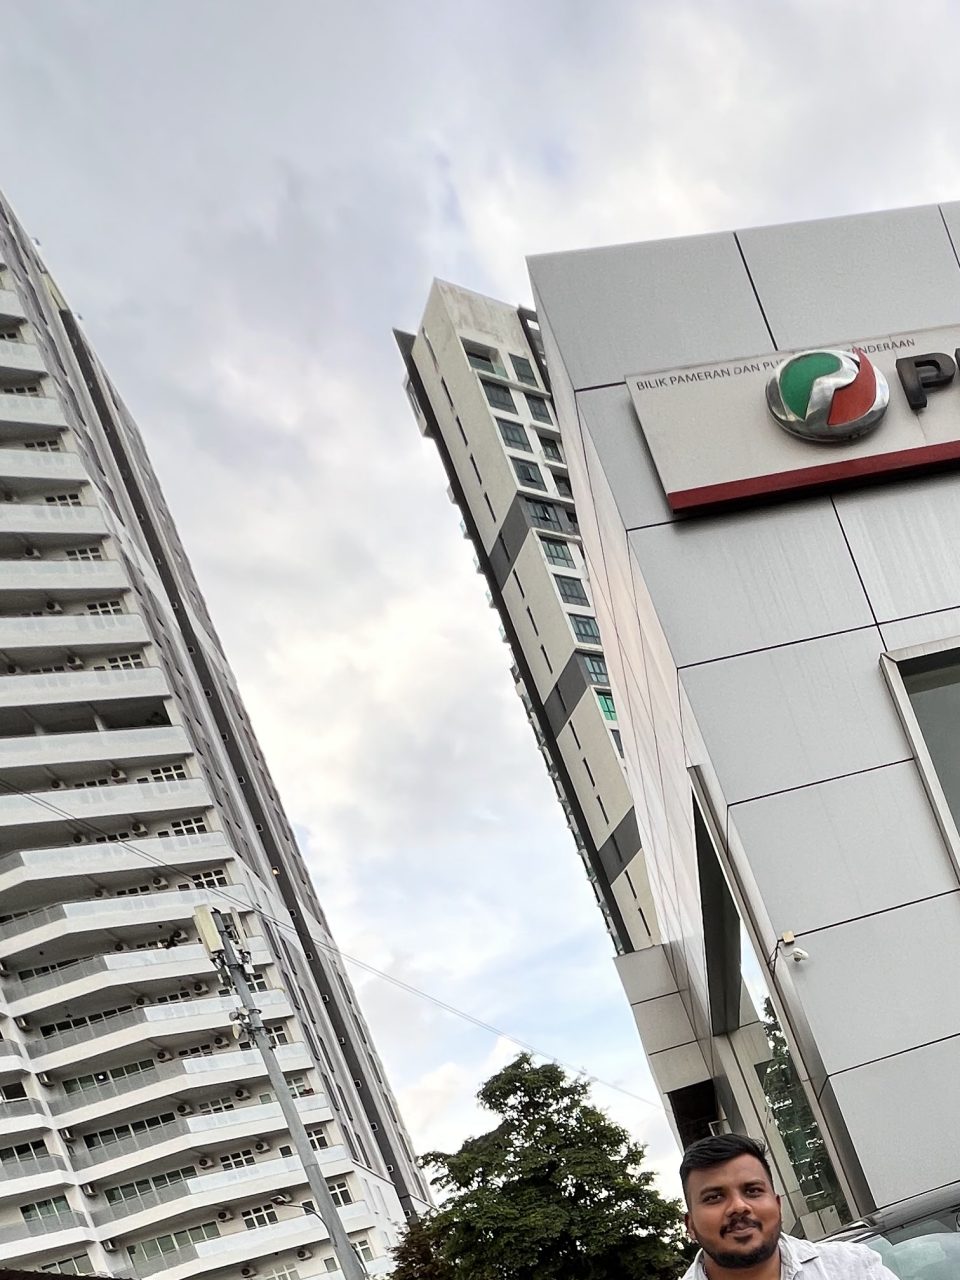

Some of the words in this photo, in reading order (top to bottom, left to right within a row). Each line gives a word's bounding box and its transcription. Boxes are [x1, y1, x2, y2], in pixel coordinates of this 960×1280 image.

[636, 377, 668, 391] BILIK
[669, 368, 731, 385] PAMERAN
[733, 363, 761, 375] DAN
